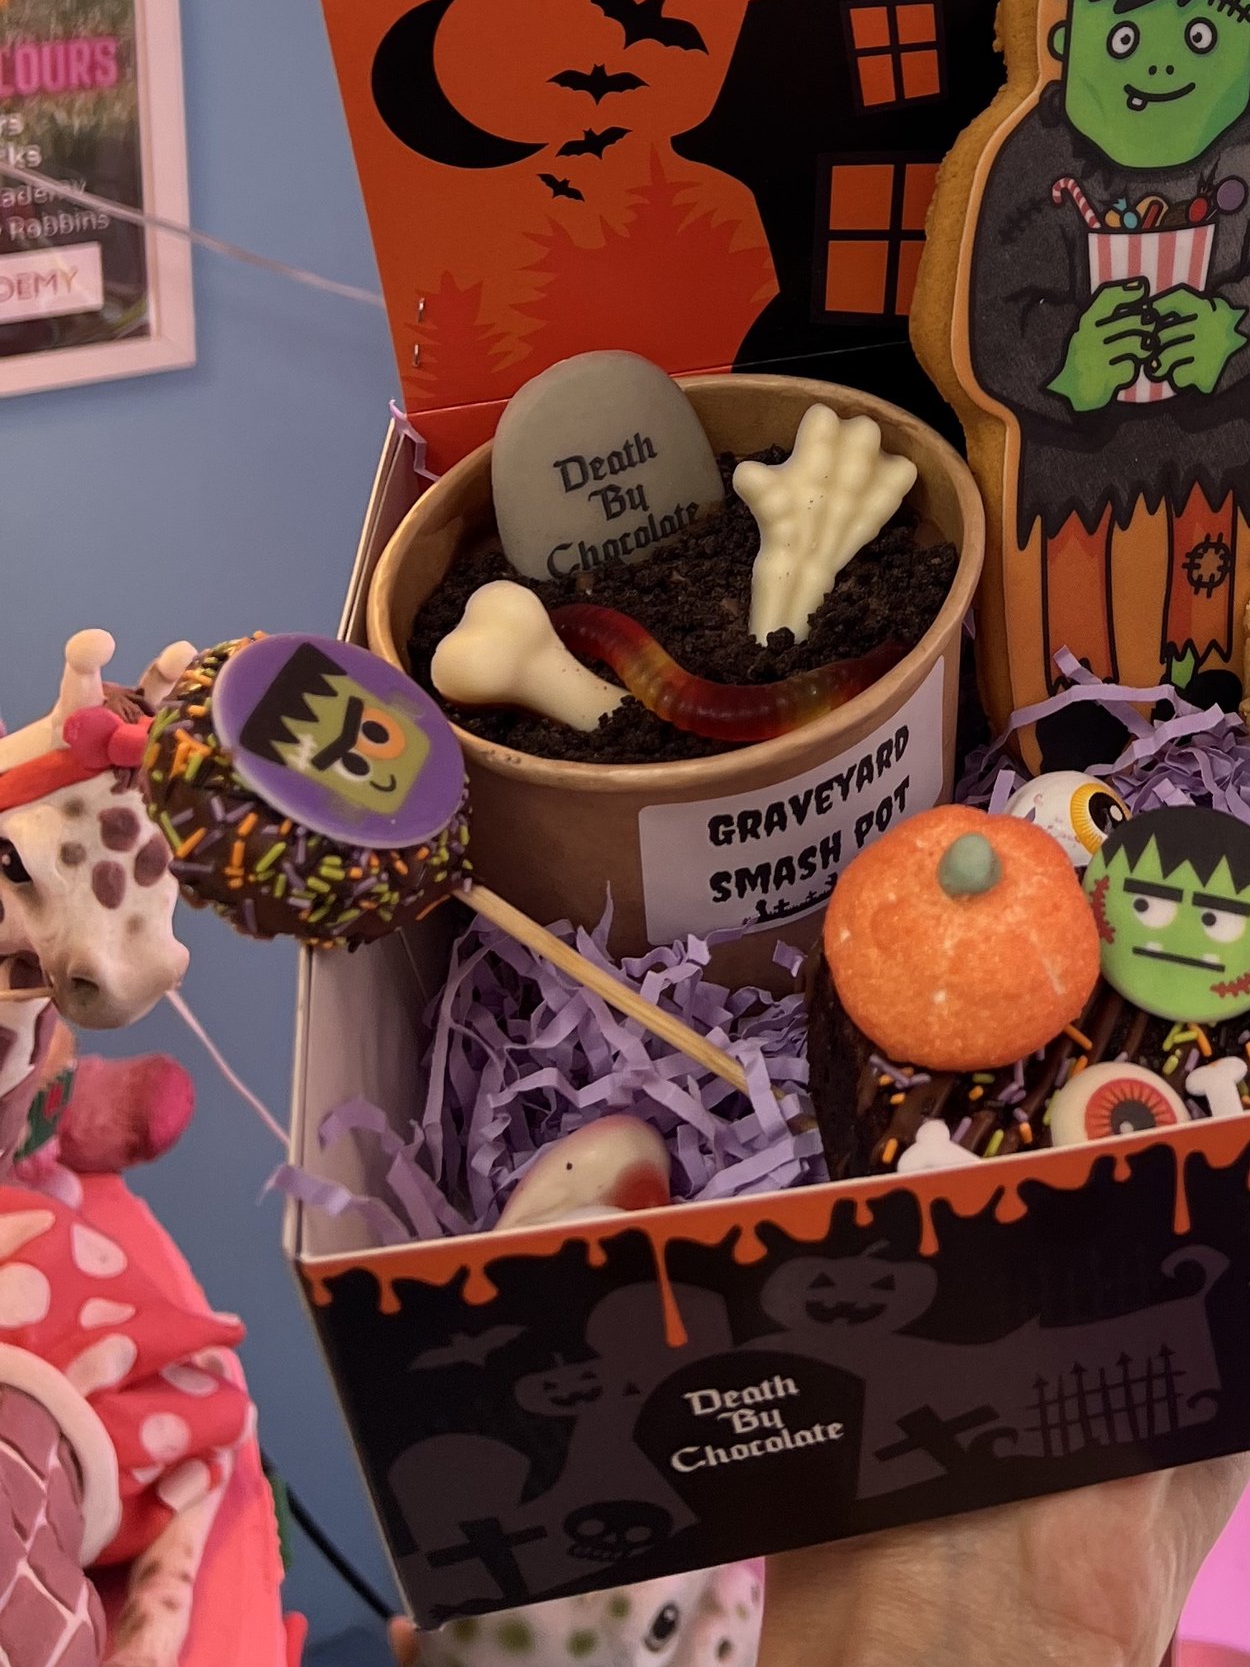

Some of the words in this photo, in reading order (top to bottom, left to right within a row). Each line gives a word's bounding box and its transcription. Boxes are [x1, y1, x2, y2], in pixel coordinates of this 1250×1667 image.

[553, 432, 658, 493] Death
[588, 484, 650, 521] By
[547, 501, 700, 579] Chocolate
[708, 725, 910, 847] GRAVEYARD
[709, 829, 842, 903] SMASH
[854, 774, 910, 849] POT
[682, 1374, 800, 1416] Death
[717, 1407, 786, 1434] By
[669, 1421, 845, 1473] Chocolate
